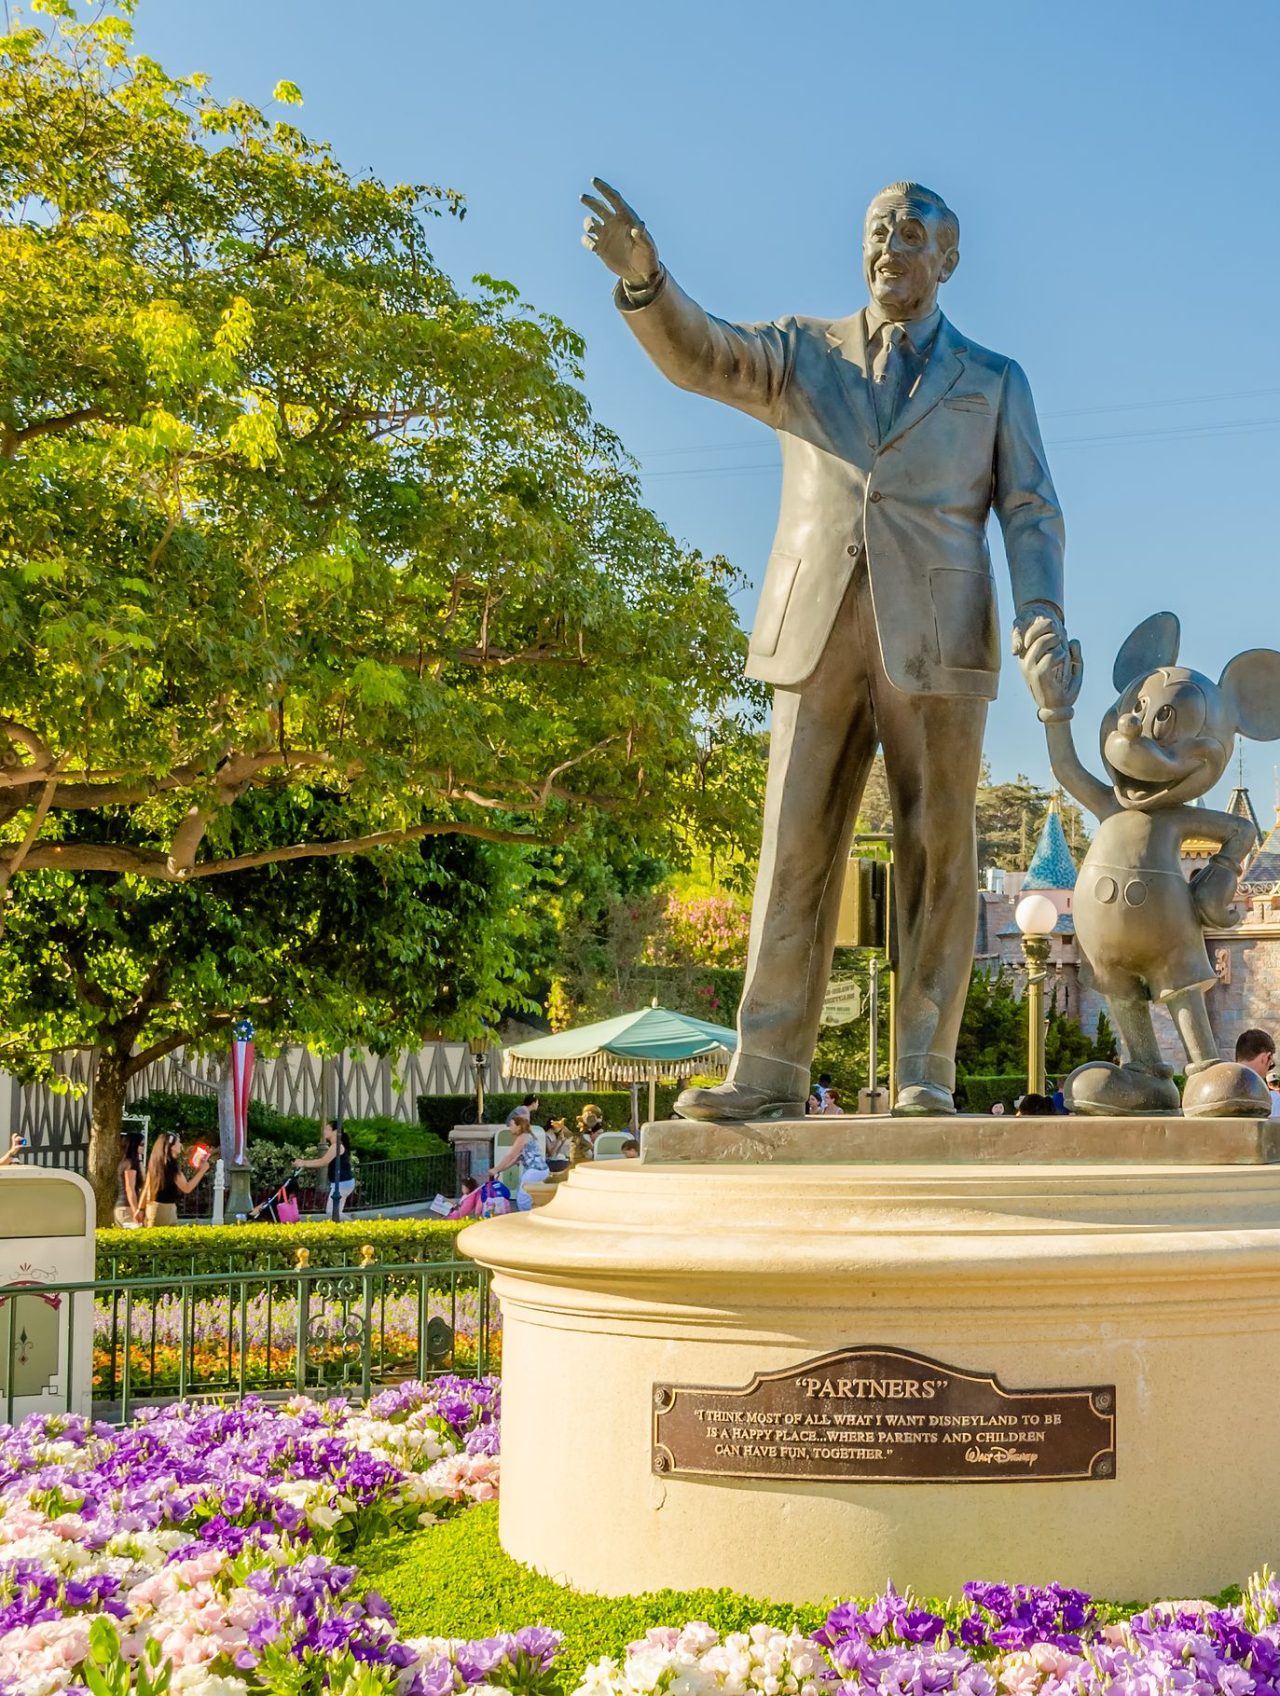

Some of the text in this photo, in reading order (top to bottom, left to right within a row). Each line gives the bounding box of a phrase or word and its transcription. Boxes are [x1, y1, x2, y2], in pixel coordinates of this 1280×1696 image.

[796, 1377, 948, 1399] “PARTNERS”
[707, 1411, 743, 1423] THINK
[746, 1412, 782, 1425] MOST
[784, 1413, 801, 1425] OF
[805, 1414, 831, 1425] ALL
[834, 1414, 872, 1426] WHAT
[885, 1415, 925, 1426] WANT
[928, 1414, 1018, 1426] DISNEYLAND
[1022, 1414, 1040, 1425] TO
[1044, 1413, 1062, 1425] BE
[706, 1427, 718, 1438] IS
[721, 1428, 730, 1439] A
[733, 1428, 771, 1441] HAPPY
[878, 1432, 938, 1443] PARENTS
[942, 1432, 972, 1443] AND
[976, 1431, 1045, 1443] CHILDREN
[714, 1443, 740, 1456] CAN
[742, 1445, 777, 1457] HAVE
[779, 1446, 810, 1460] FUN,
